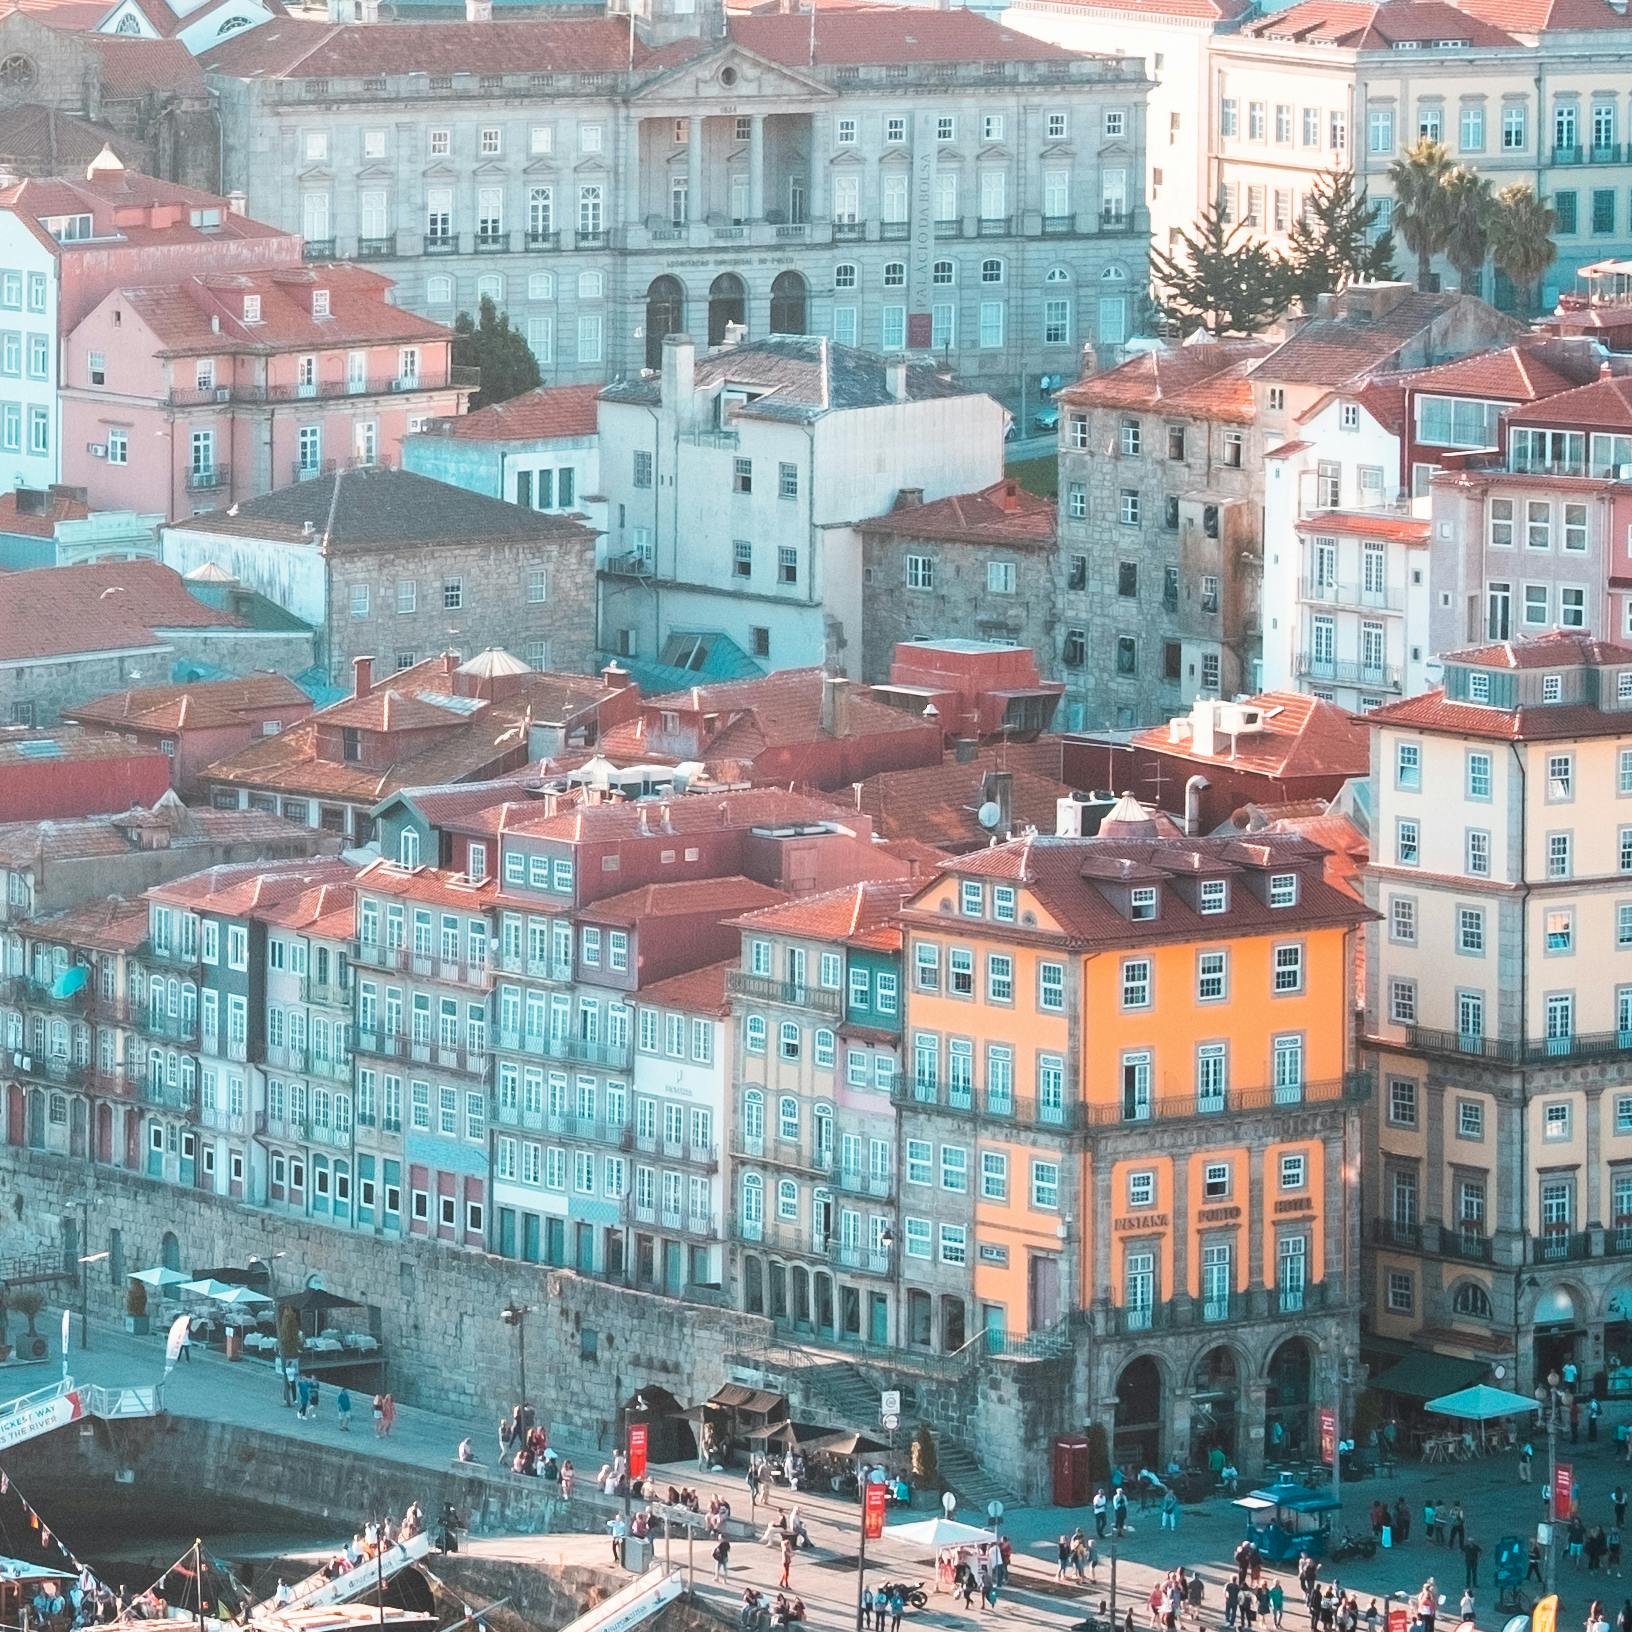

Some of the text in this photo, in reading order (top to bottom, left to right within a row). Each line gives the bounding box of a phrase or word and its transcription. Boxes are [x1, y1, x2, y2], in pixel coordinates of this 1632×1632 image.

[919, 153, 931, 202] BOLSA
[1115, 1197, 1314, 1231] PESTANA PORTO HOTEL
[36, 1404, 56, 1418] WAY
[10, 1427, 28, 1439] THE
[29, 1416, 57, 1432] RIVER
